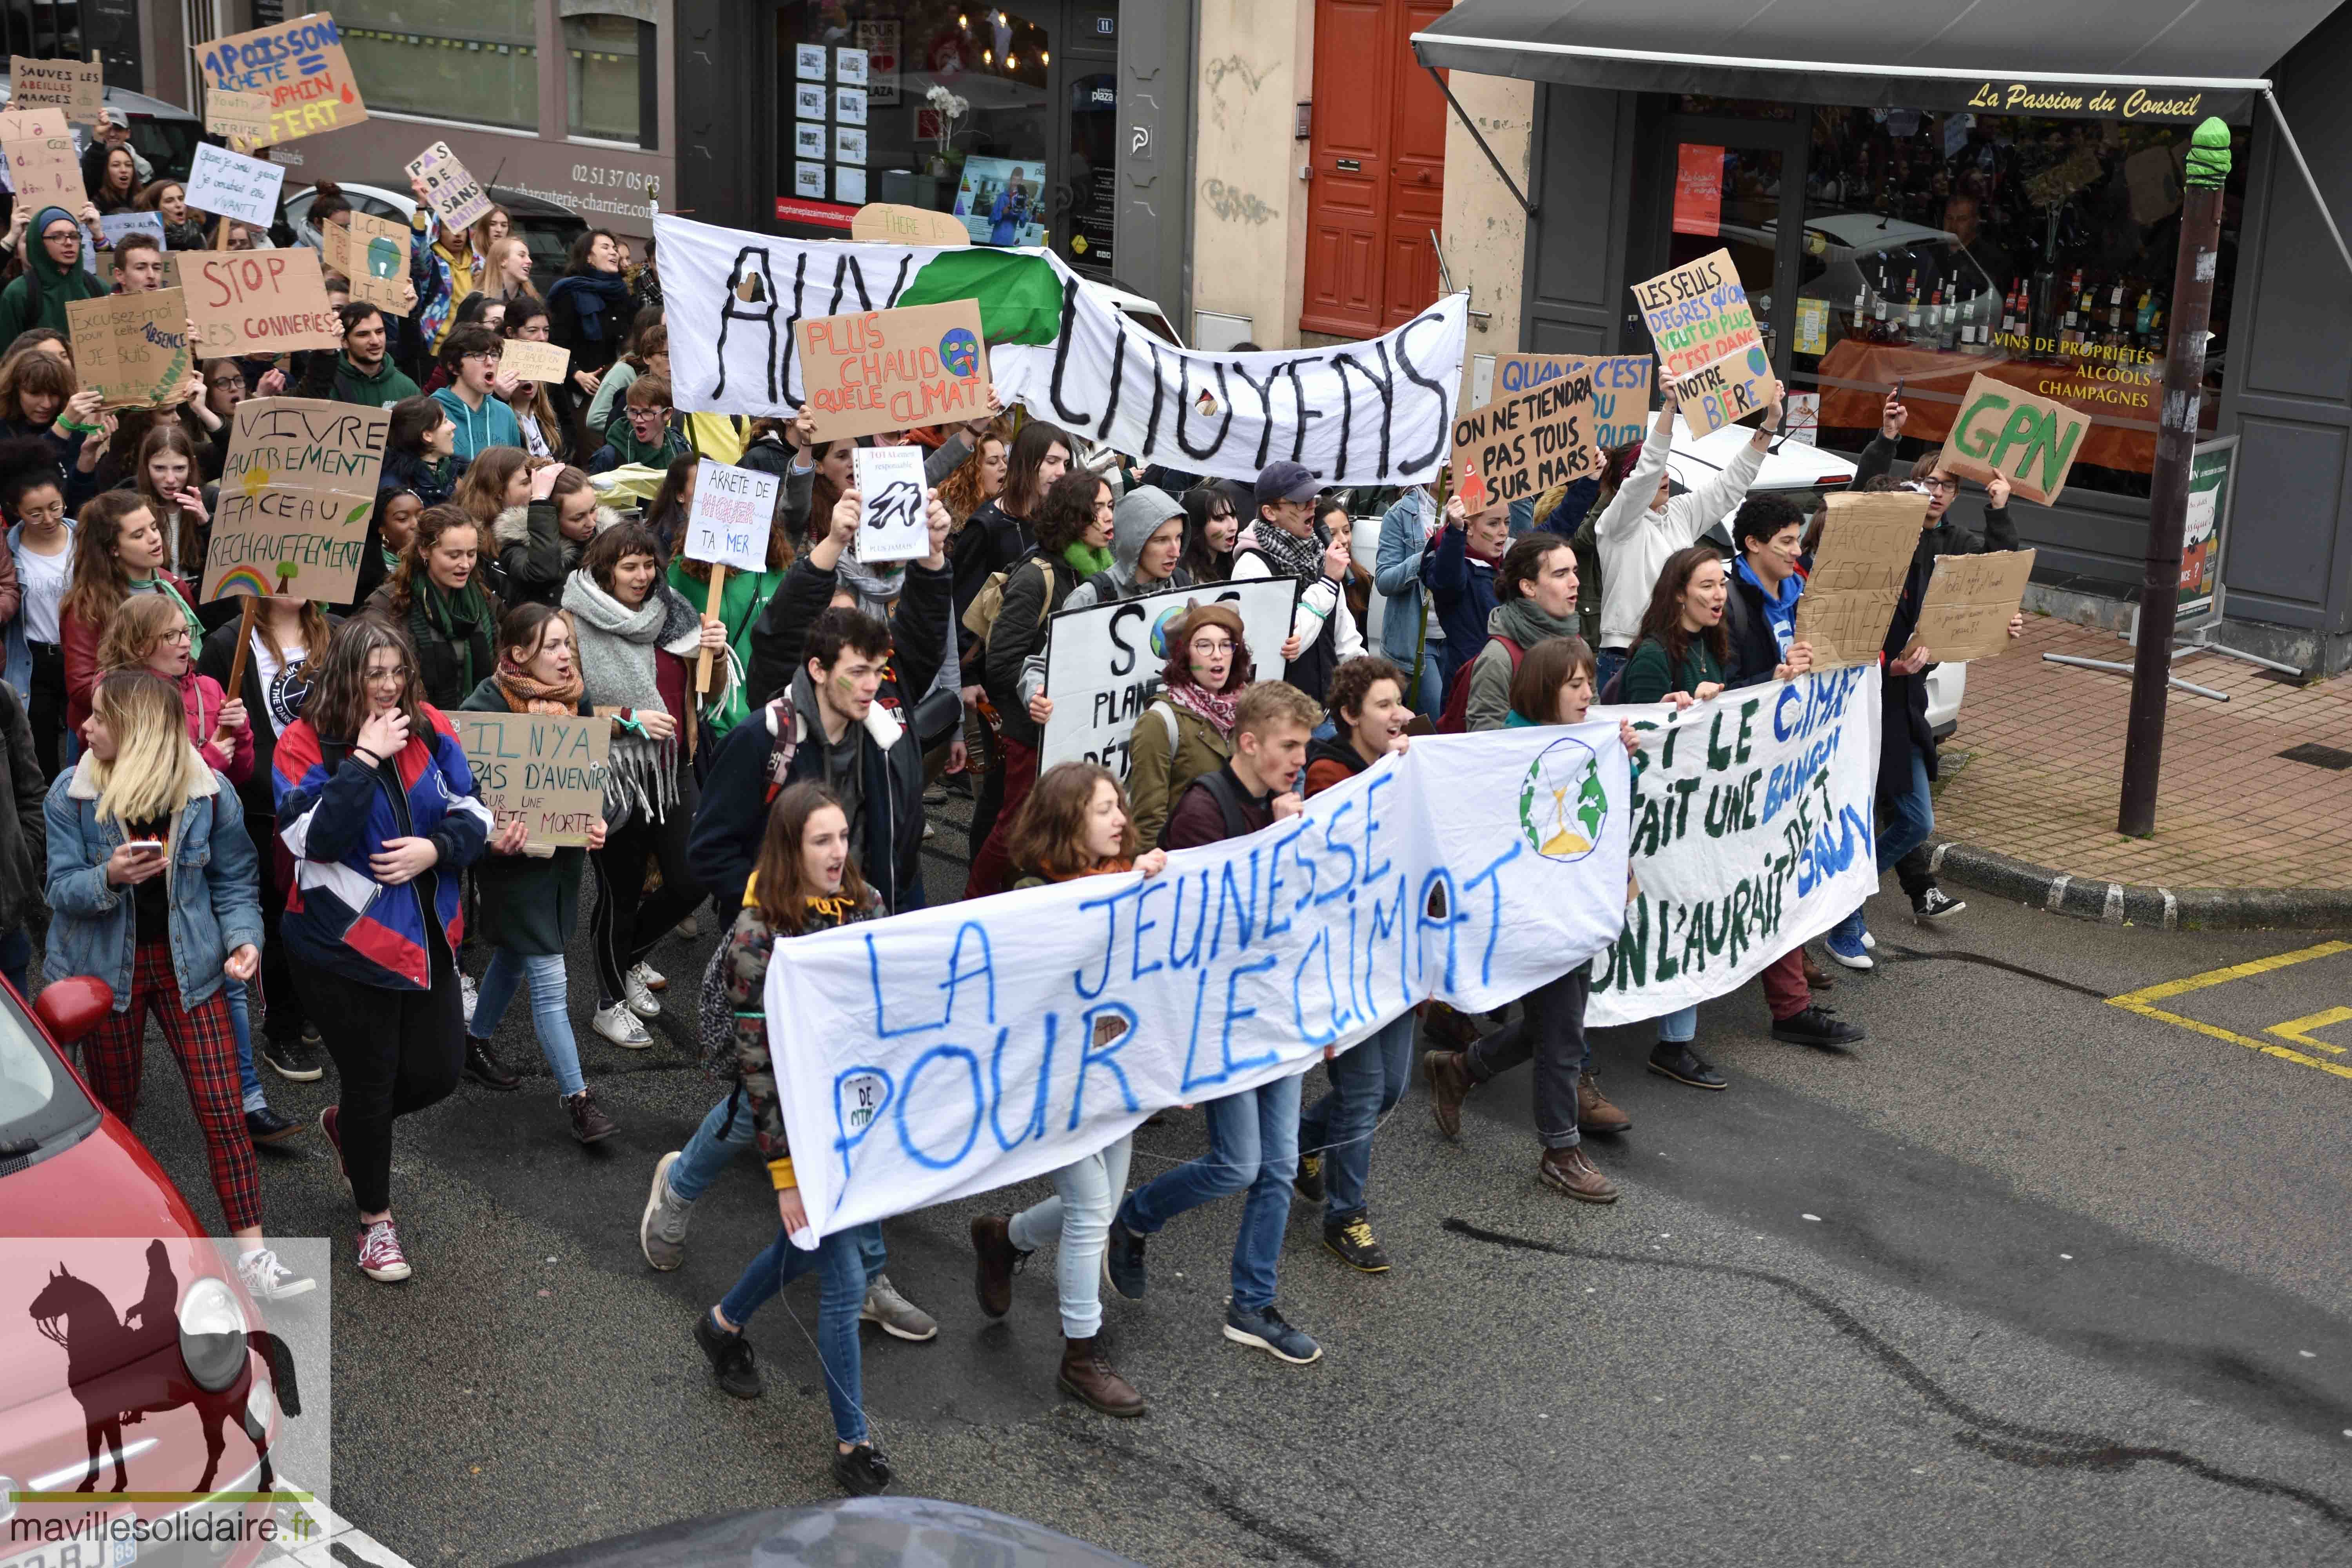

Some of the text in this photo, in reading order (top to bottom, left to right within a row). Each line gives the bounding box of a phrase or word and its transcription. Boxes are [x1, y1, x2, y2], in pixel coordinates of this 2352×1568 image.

[1101, 20, 1109, 31] 11
[219, 20, 340, 74] POISSON
[20, 65, 99, 83] SAUVEZ LES
[20, 80, 72, 93] ABEILLES
[270, 72, 335, 108] UPHIN
[18, 93, 71, 104] MANGEZ
[1092, 89, 1114, 102] plaza
[1968, 83, 2201, 118] La Passion du Conseil
[410, 145, 448, 176] PAS
[573, 164, 588, 182] 02
[590, 167, 605, 186] 51
[609, 170, 624, 187] 37
[626, 172, 641, 190] 05
[426, 168, 451, 189] DE
[441, 181, 479, 214] SANS
[879, 206, 920, 235] THERE
[203, 257, 285, 307] STOP
[1639, 261, 1722, 311] LES SEULS
[75, 330, 103, 353] pour
[140, 321, 187, 349] ABSENCE
[244, 312, 334, 338] CONNERIES
[807, 312, 885, 355] PLUS
[1656, 309, 1752, 352] VEUT EN PLUS
[84, 344, 151, 367] JE SUIS
[1668, 344, 1710, 377] C'EST
[1994, 332, 2155, 365] VINS DE PROPRIÉTÉS
[840, 346, 939, 387] CHAUD
[1593, 358, 1652, 389] C'EST
[2076, 364, 2152, 387] ALCOOLS
[813, 387, 856, 414] QUE
[857, 384, 886, 410] LE
[1676, 365, 1726, 402] NOTRE
[2038, 380, 2149, 408] CHAMPAGNES
[1455, 374, 1594, 447] ON NE TIENDRA
[240, 408, 388, 451] VIVRE
[1954, 392, 2082, 496] GPN
[225, 443, 381, 481] AUTREMENT
[1483, 416, 1580, 477] PAS TOUS
[755, 481, 771, 498] DE
[1486, 444, 1590, 506] SUR MARS
[223, 493, 339, 530] FACE AU
[208, 531, 365, 576] RECHAUFFEMENT
[702, 530, 749, 557] TA MER
[272, 688, 293, 725] THE DARK
[467, 722, 521, 759] IL
[1707, 698, 1761, 772] LE
[466, 760, 606, 792] PAS D'AVENIR
[480, 793, 545, 809] SUR UNE
[1704, 768, 1763, 839] UNE
[540, 811, 595, 835] MORTE
[1798, 794, 1871, 898] SAUV
[864, 771, 1396, 1039] LA JEUNESSE
[833, 1000, 1142, 1211] POUR
[1180, 955, 1281, 1093] LE
[858, 1086, 874, 1107] DE
[115, 1543, 134, 1562] 85
